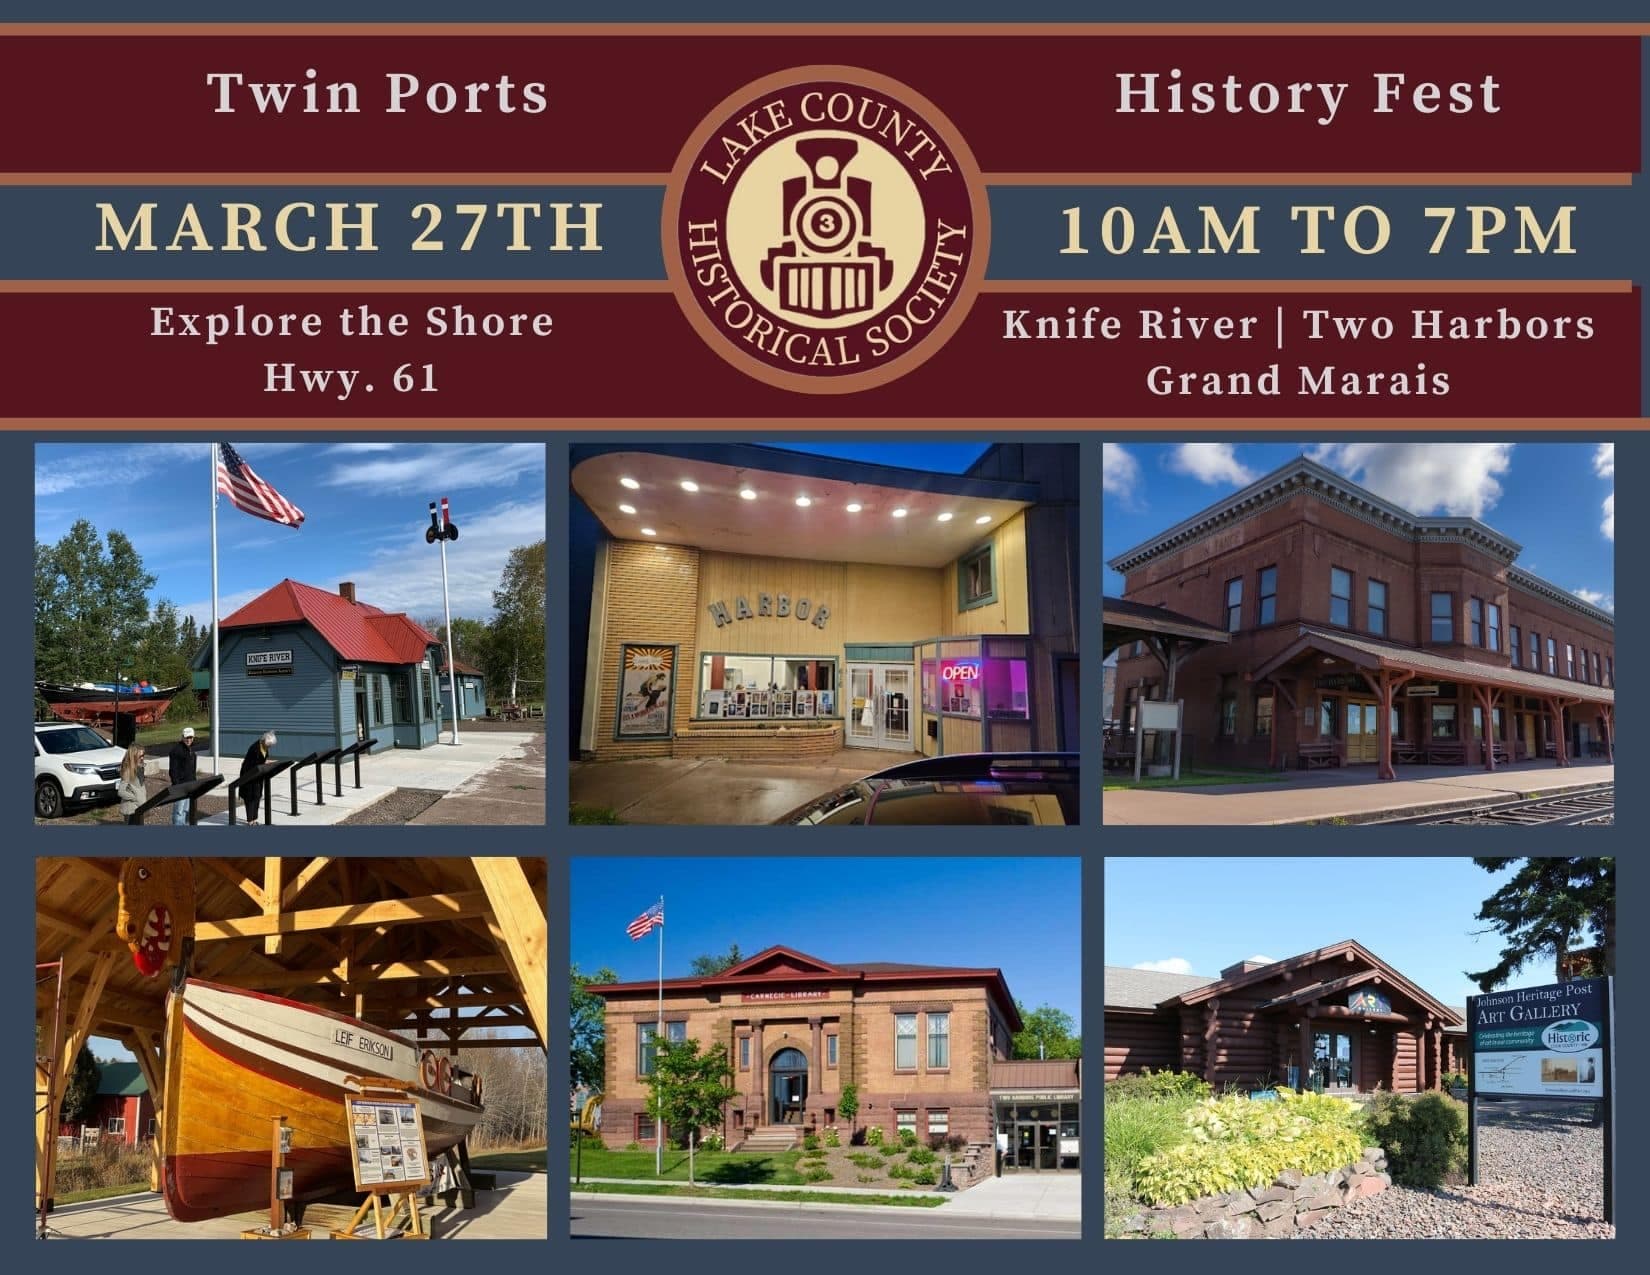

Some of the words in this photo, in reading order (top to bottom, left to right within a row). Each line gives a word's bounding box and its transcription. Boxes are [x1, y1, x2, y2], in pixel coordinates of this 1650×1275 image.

[708, 592, 831, 629] HARBOR
[248, 655, 268, 663] KNIFE
[269, 653, 290, 662] RIVER
[943, 666, 978, 680] OPEN
[1477, 995, 1514, 1008] Johnson
[1517, 988, 1562, 1003] Heritage
[1566, 983, 1593, 997] Post
[1478, 1009, 1506, 1025] ART
[1510, 1003, 1581, 1021] GALLERY
[336, 1030, 354, 1045] LEIF
[359, 1036, 390, 1057] ERIKSON
[1548, 1031, 1591, 1043] Historic
